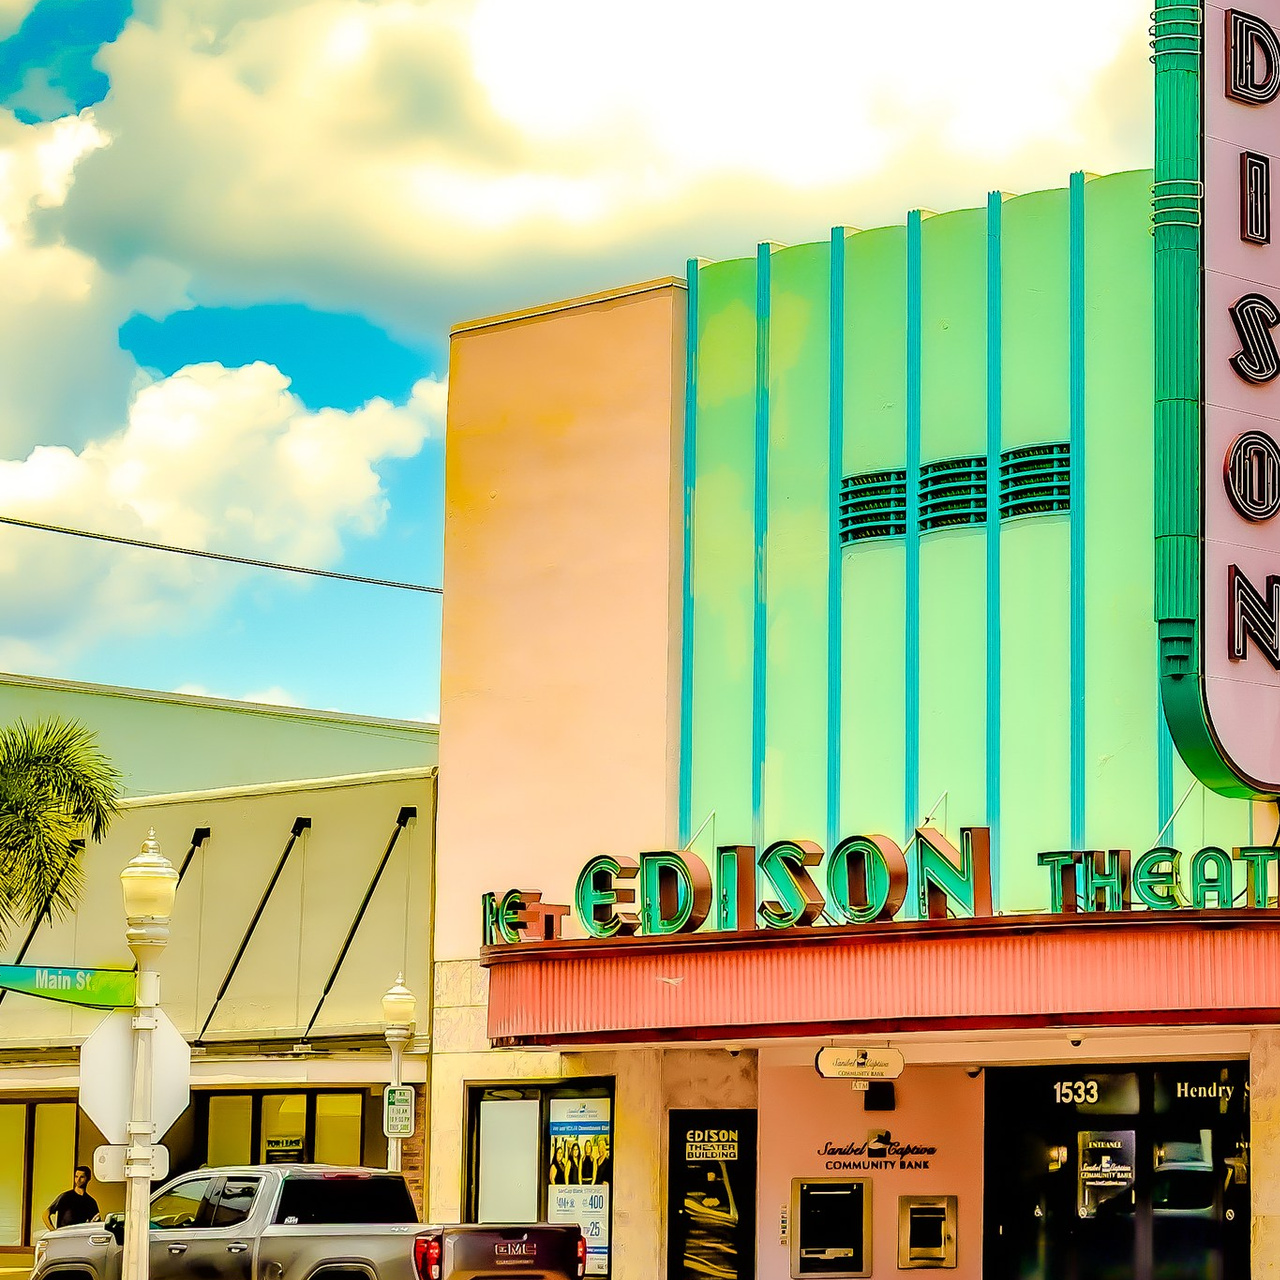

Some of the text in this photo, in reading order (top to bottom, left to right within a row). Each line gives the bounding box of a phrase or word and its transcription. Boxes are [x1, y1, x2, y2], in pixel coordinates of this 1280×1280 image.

[575, 827, 991, 939] EDISON
[35, 969, 71, 990] Main
[851, 1082, 869, 1090] ATM
[1053, 1081, 1099, 1105] 1533
[1176, 1081, 1235, 1102] Hendry
[686, 1129, 738, 1142] EDISON
[688, 1143, 735, 1151] THEATER
[817, 1141, 938, 1160] Sanibel Captiva
[687, 1151, 737, 1159] BUILDING
[825, 1160, 930, 1170] COMMUNITY BANK
[588, 1195, 604, 1210] 400
[590, 1221, 600, 1237] 25
[494, 1243, 537, 1256] GMC
